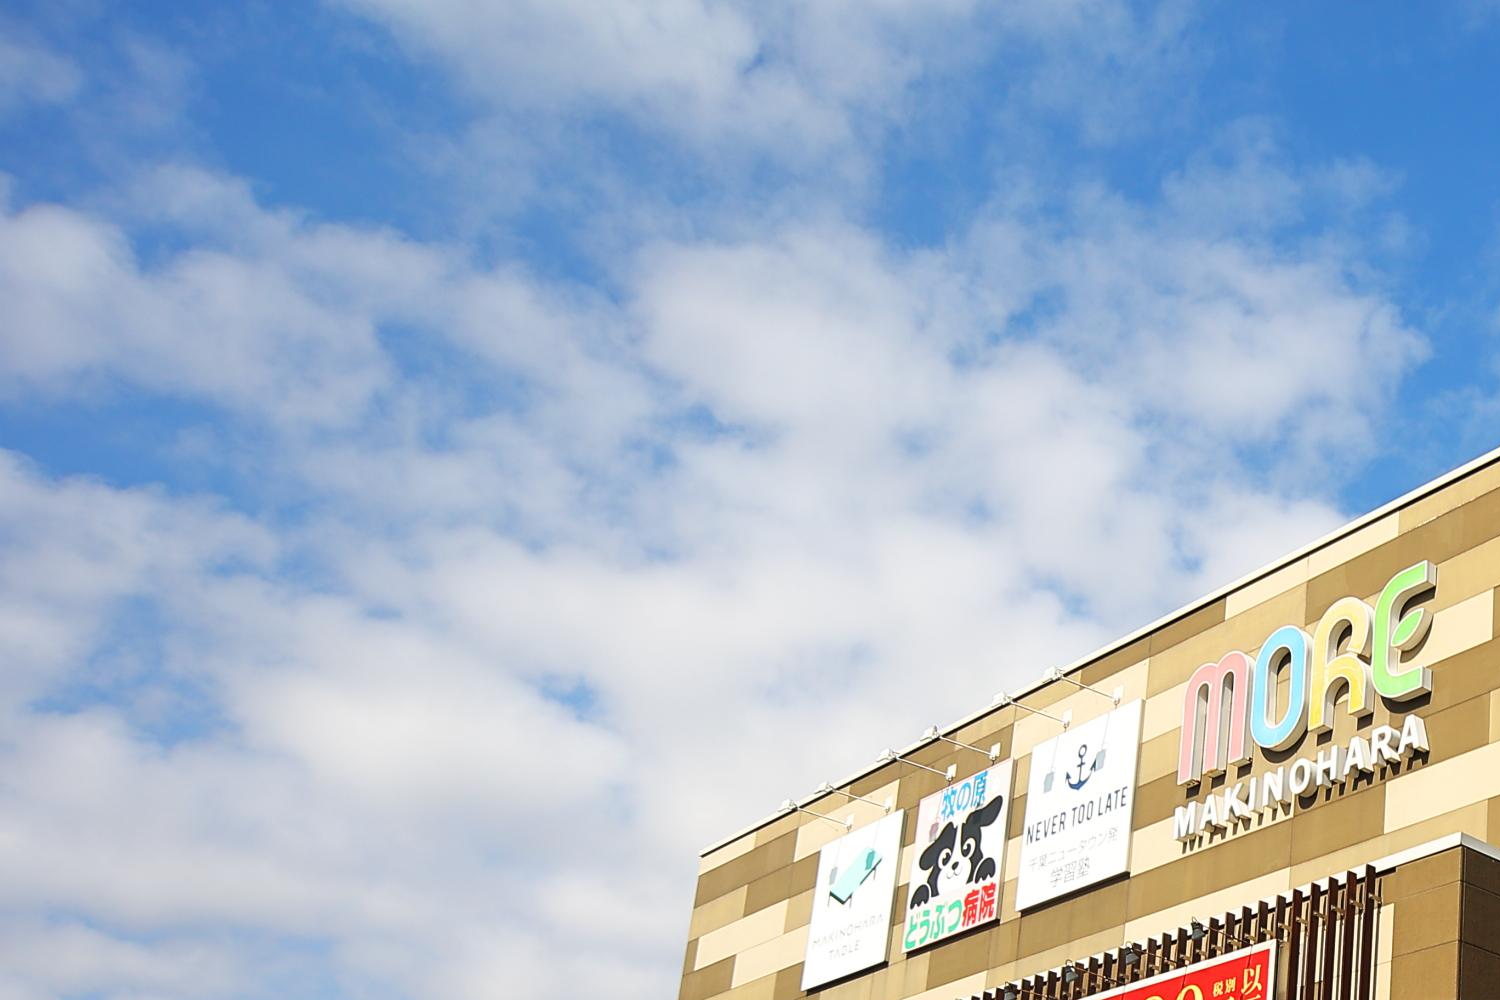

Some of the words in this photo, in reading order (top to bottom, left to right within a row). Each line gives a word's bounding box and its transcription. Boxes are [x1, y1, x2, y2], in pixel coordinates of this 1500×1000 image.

[1177, 560, 1436, 787] MORE
[941, 770, 988, 821] 牧の原
[1173, 714, 1430, 841] MAKINOHARA
[1026, 811, 1066, 845] NEVER
[1072, 800, 1094, 827] TOO
[1098, 786, 1128, 816] LATE
[1050, 855, 1090, 888] 学習塾
[811, 913, 884, 947] MAKINOHARA
[905, 882, 997, 949] どうぶつ病院
